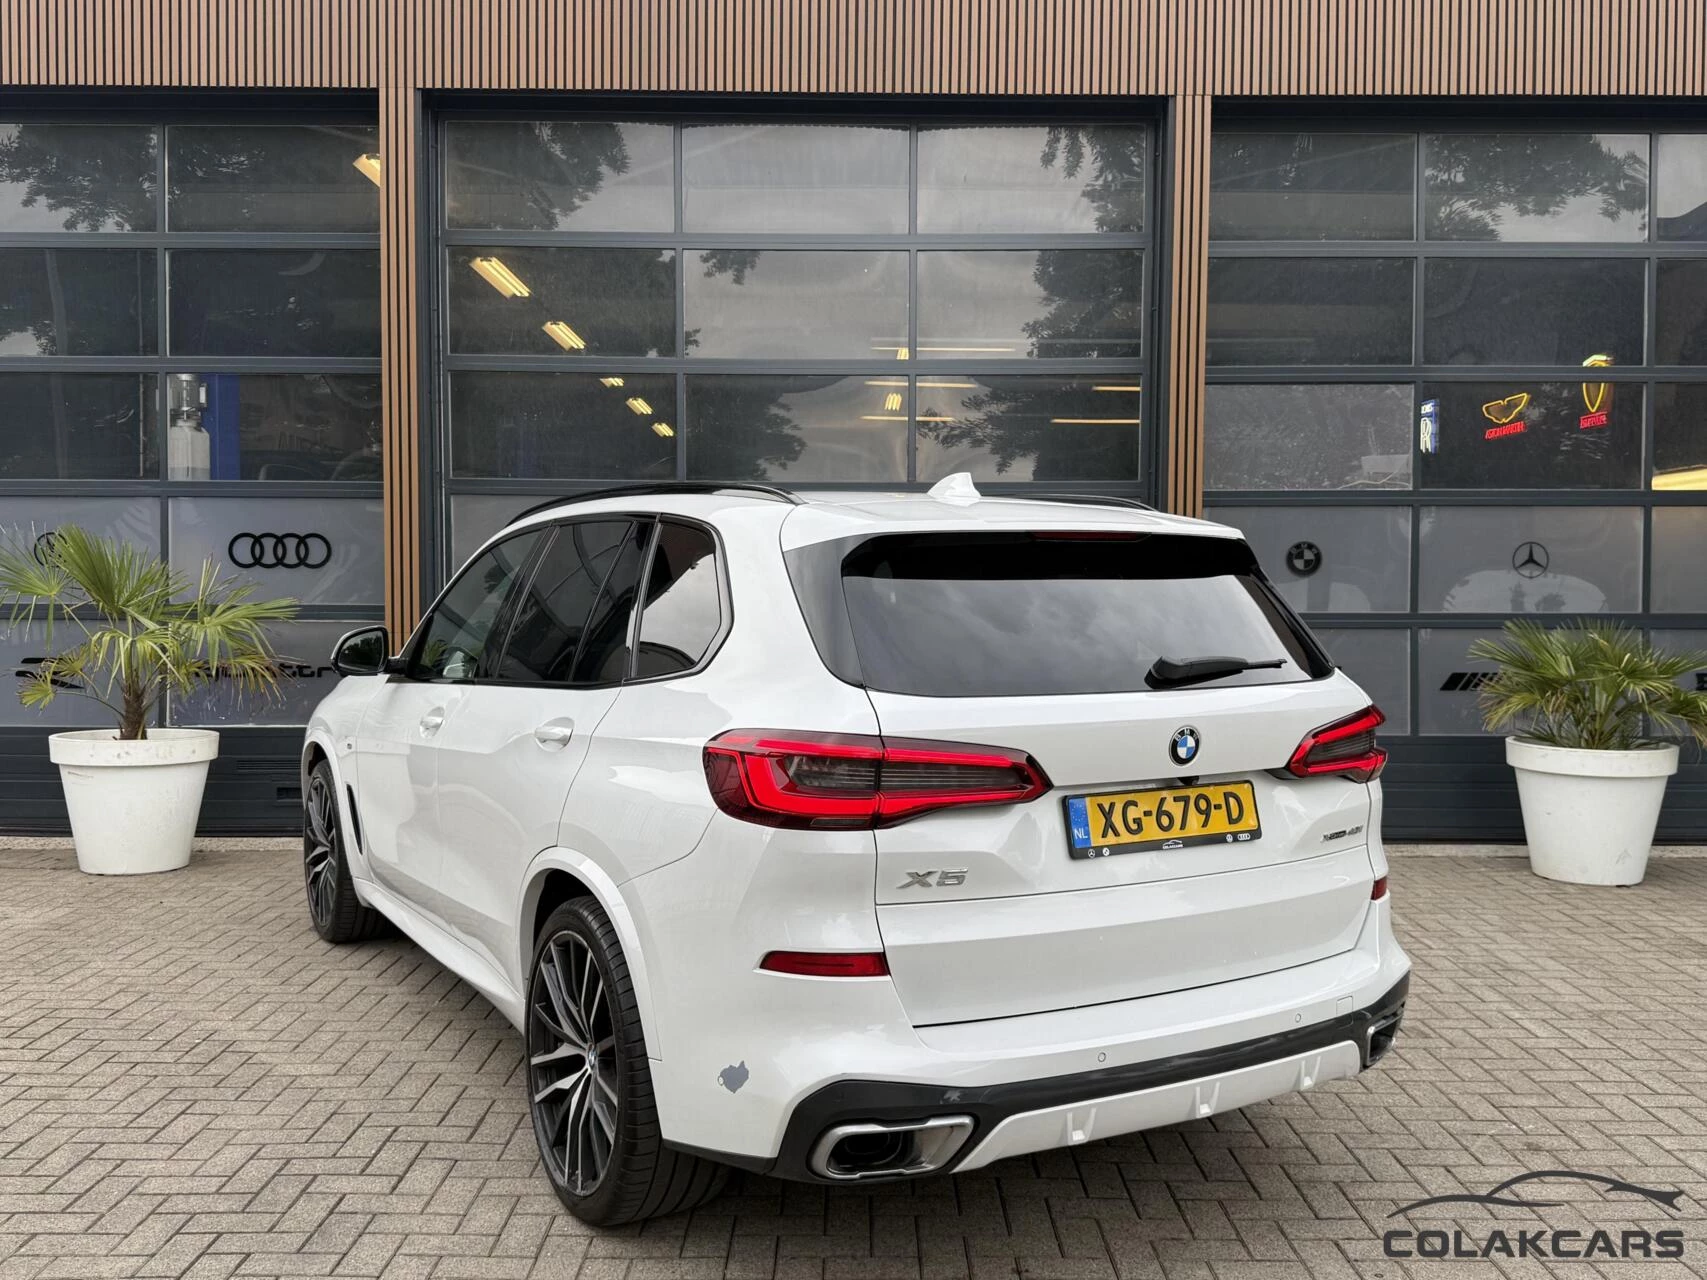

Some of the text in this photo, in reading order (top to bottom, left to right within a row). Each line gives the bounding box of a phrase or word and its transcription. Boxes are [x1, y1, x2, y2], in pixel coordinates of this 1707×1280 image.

[1097, 791, 1244, 839] XG-679-D
[1074, 827, 1088, 839] NL
[896, 867, 968, 889] X5
